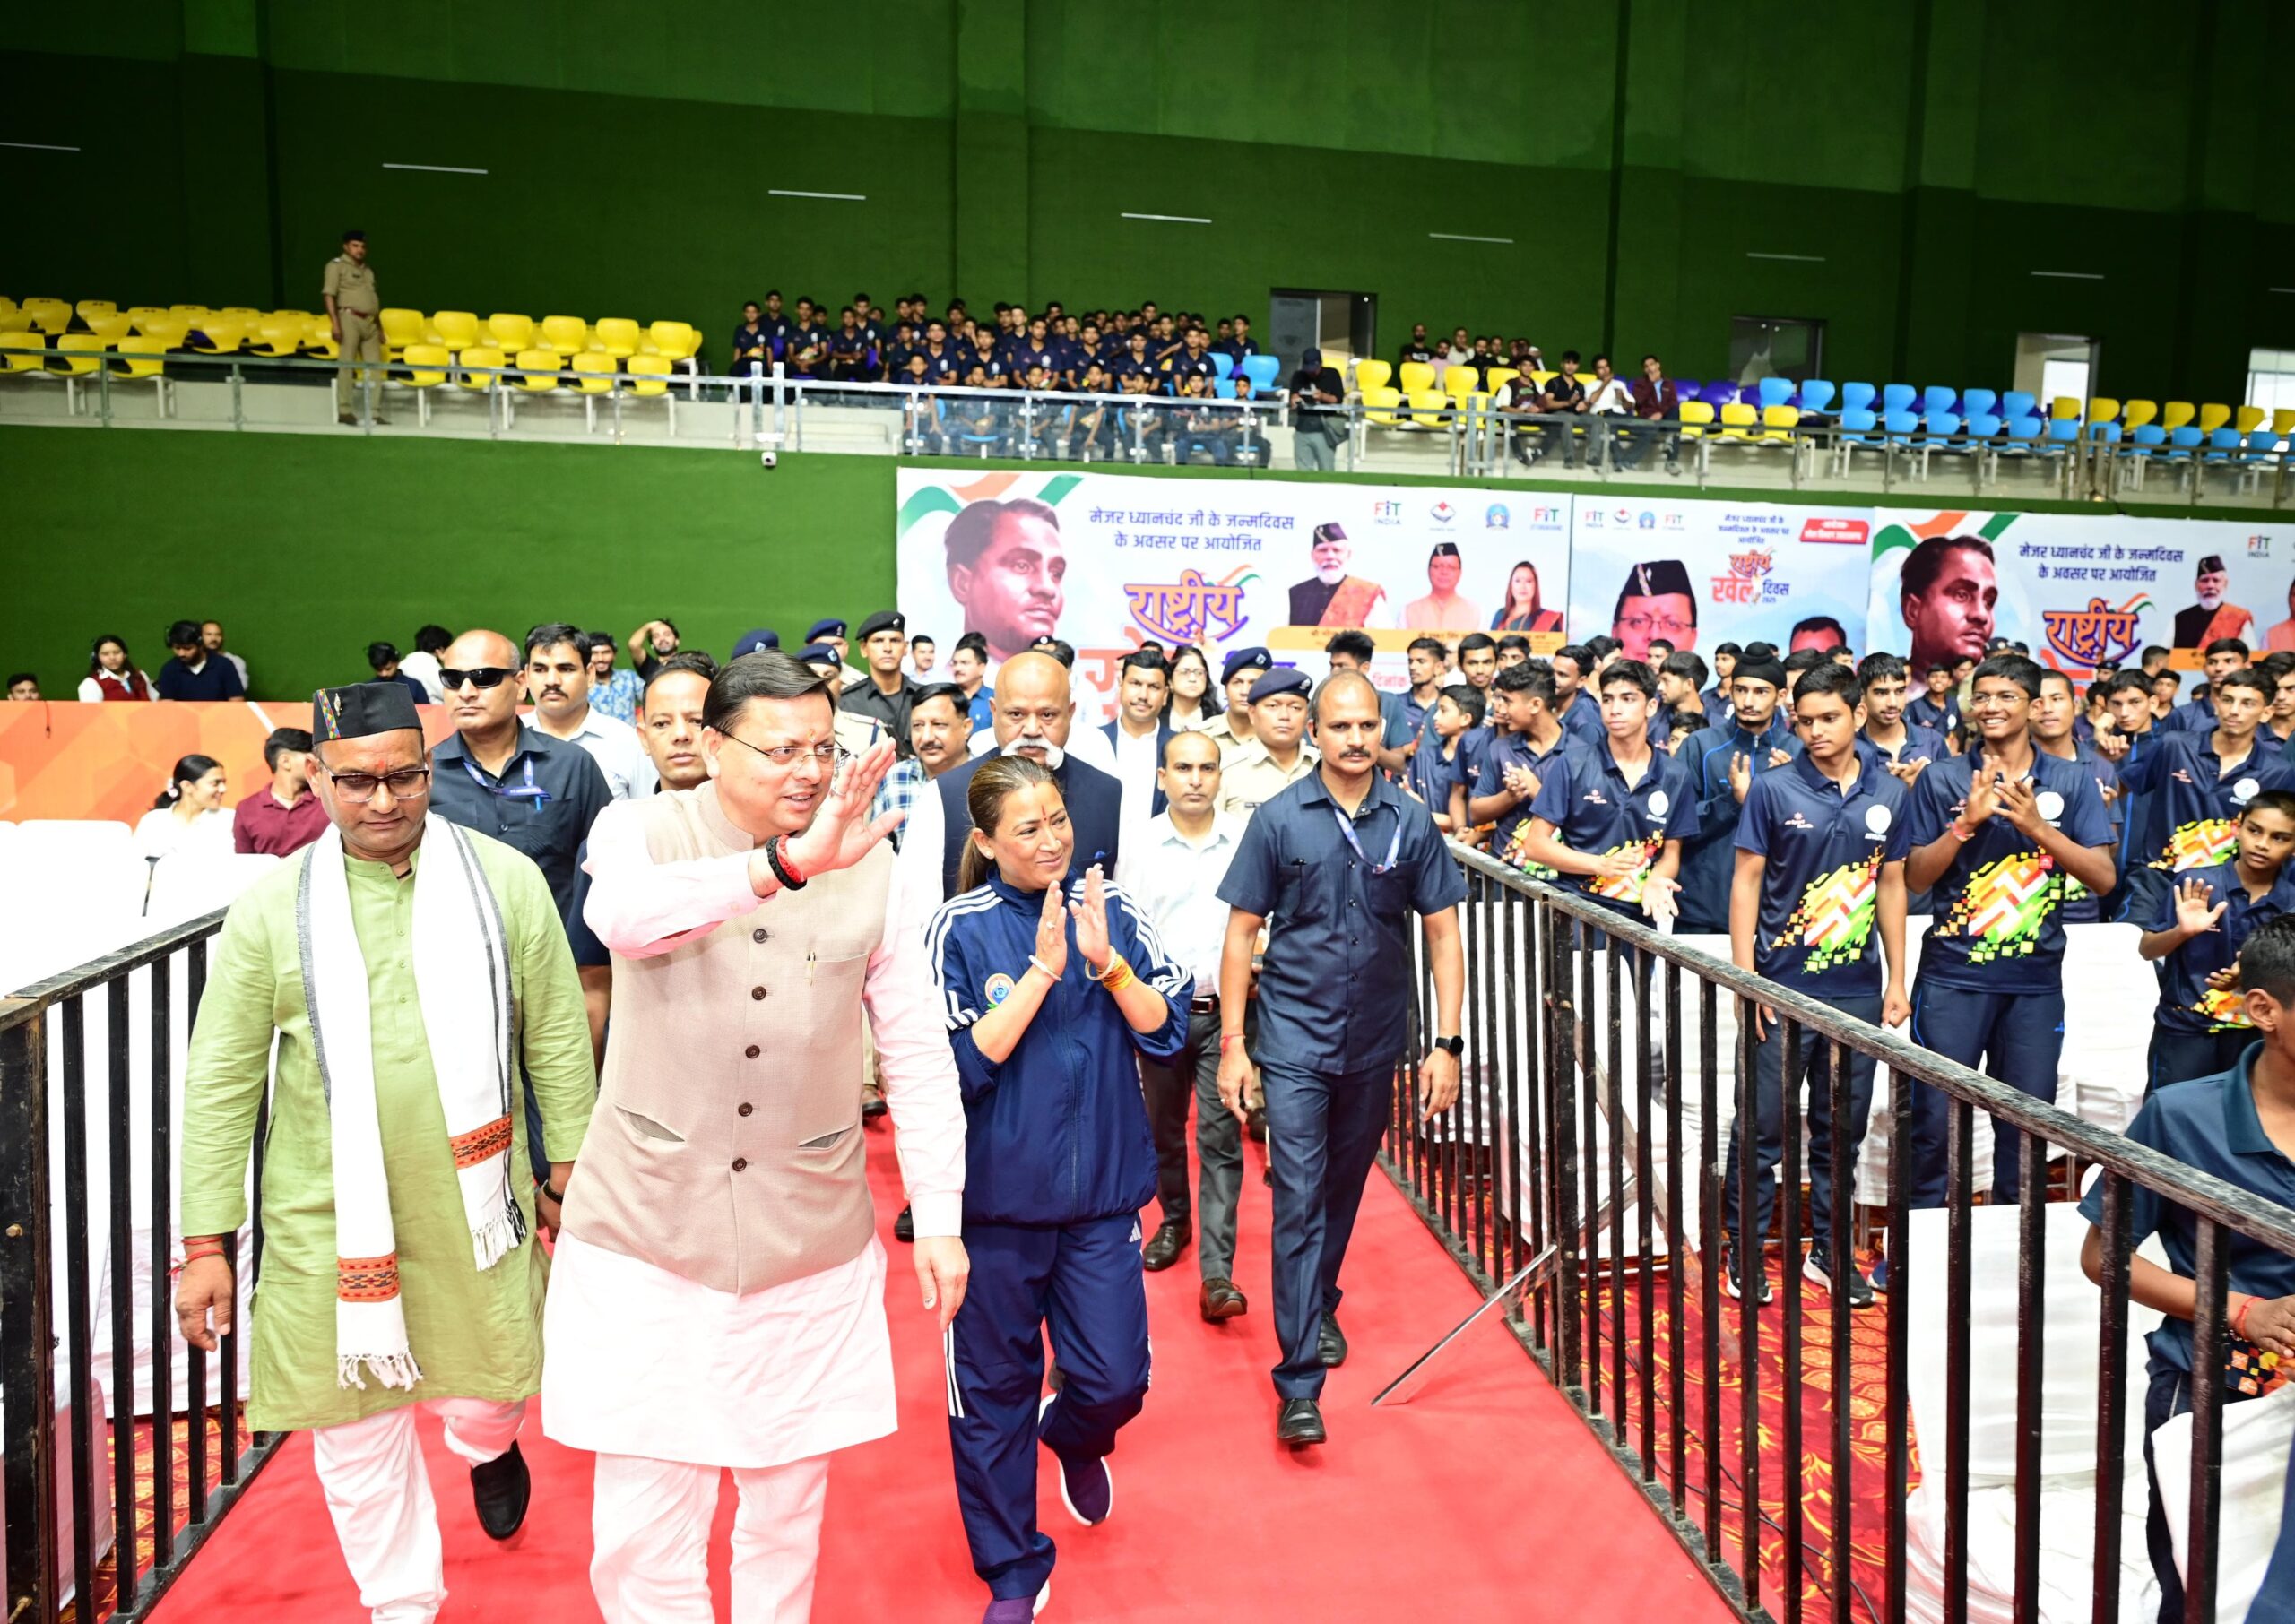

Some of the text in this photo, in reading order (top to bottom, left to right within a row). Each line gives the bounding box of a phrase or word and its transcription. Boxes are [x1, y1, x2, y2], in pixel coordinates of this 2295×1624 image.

[1373, 500, 1402, 516] FIT
[1534, 506, 1560, 522] FIT
[1089, 506, 1295, 530] मेजर ध्यानचंद जी के जन्मदिवस
[1114, 531, 1262, 551] के अवसर पर आयोजित
[2248, 535, 2272, 549] FIT
[2019, 541, 2184, 563] मेजर ध्यानचंद जी के जन्मदिवस
[2038, 563, 2157, 582] के अवसर पर आयोजित
[1762, 579, 1790, 596] दिवस
[1123, 569, 1249, 644] राष्ट्रीय
[2042, 597, 2141, 667] राष्ट्रीय
